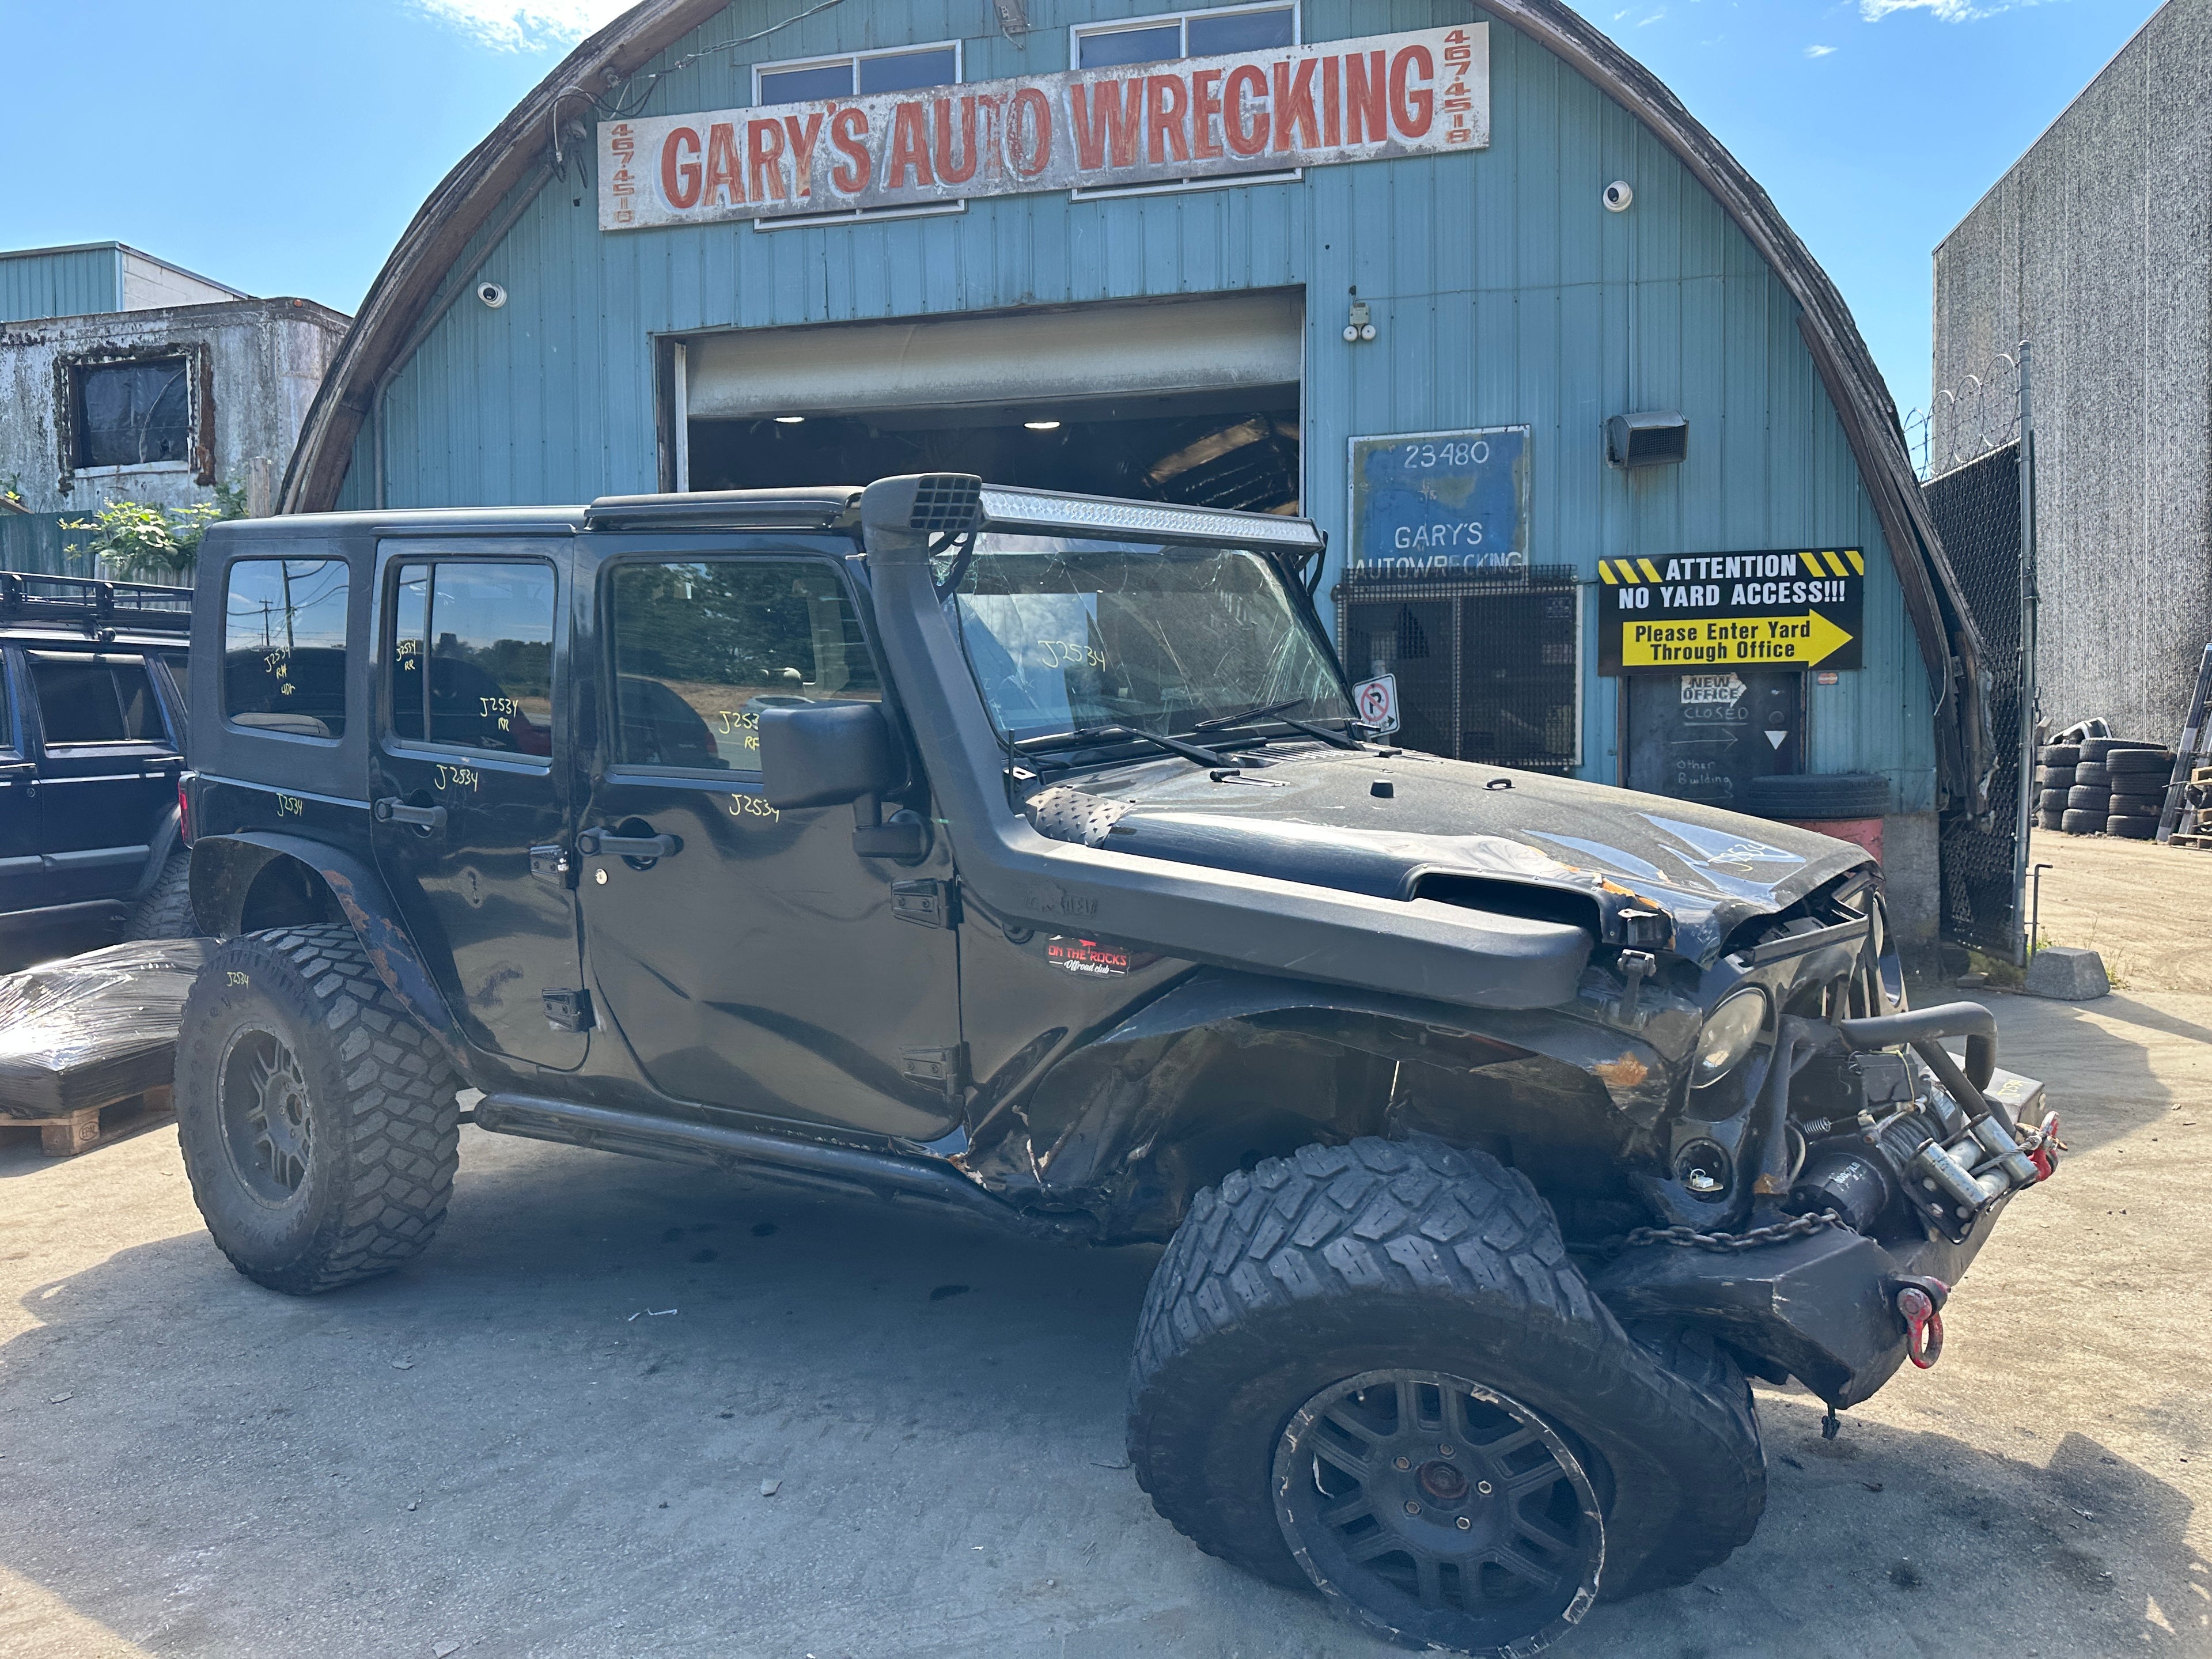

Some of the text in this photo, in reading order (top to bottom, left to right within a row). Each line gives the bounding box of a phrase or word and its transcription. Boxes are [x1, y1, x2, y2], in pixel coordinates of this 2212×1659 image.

[661, 44, 1434, 209] GARY'S AUTO WRECKING
[1404, 441, 1490, 468] 23480
[1395, 521, 1483, 548] GARY'S
[1665, 554, 1797, 581] ATTENTION
[1619, 580, 1846, 609] NO YARD ACCESS!!!
[1635, 620, 1810, 642] Please Enter Yard
[264, 643, 290, 673] J2534
[396, 639, 416, 662] J2534
[1037, 641, 1105, 672] J2534
[1650, 640, 1795, 662] Through Office
[404, 659, 415, 671] RR
[1690, 676, 1729, 688] NEW
[1683, 688, 1738, 700] OFFICE
[480, 697, 518, 718] J2534
[1684, 706, 1749, 719] CLOSED
[719, 710, 760, 734] J253
[1677, 760, 1715, 770] Other
[434, 764, 478, 792] J2534
[276, 793, 302, 817] J2534
[729, 793, 780, 823] J2534
[1048, 945, 1127, 967] ON THE ROCKS
[1063, 959, 1110, 974] Offroad club
[226, 971, 249, 990] J2534
